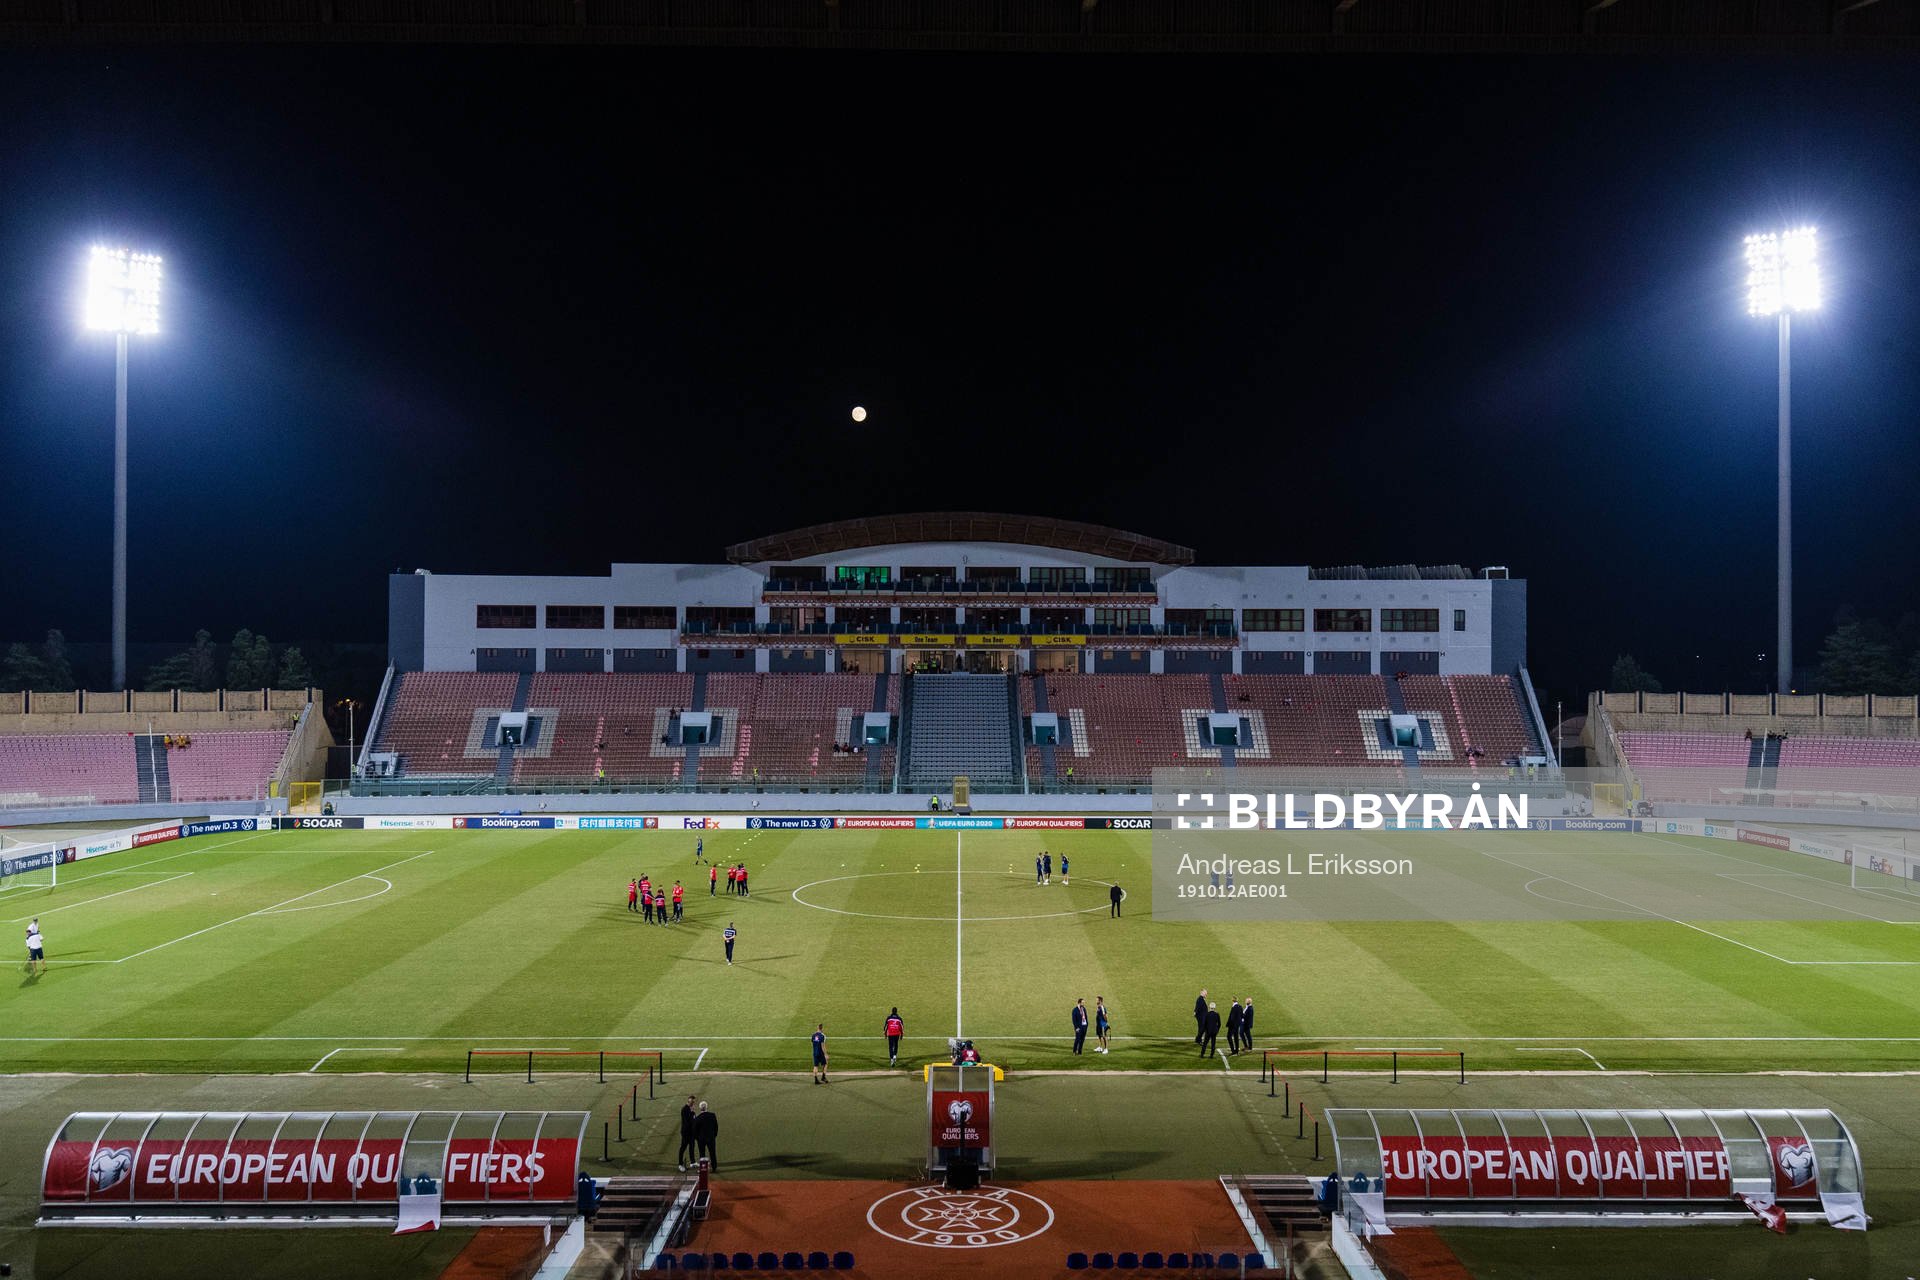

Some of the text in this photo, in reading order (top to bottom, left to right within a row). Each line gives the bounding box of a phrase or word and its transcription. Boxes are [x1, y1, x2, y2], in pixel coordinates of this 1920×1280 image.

[191, 825, 203, 833] The
[222, 821, 238, 830] ID.3
[302, 818, 343, 828] SOCAR
[482, 817, 540, 829] Booking.com
[684, 817, 720, 829] FedEx
[1113, 819, 1151, 829] SOCAR
[1565, 819, 1626, 831] Booking.com
[1870, 855, 1894, 875] FedEx
[146, 1153, 336, 1184] EUROPEAN
